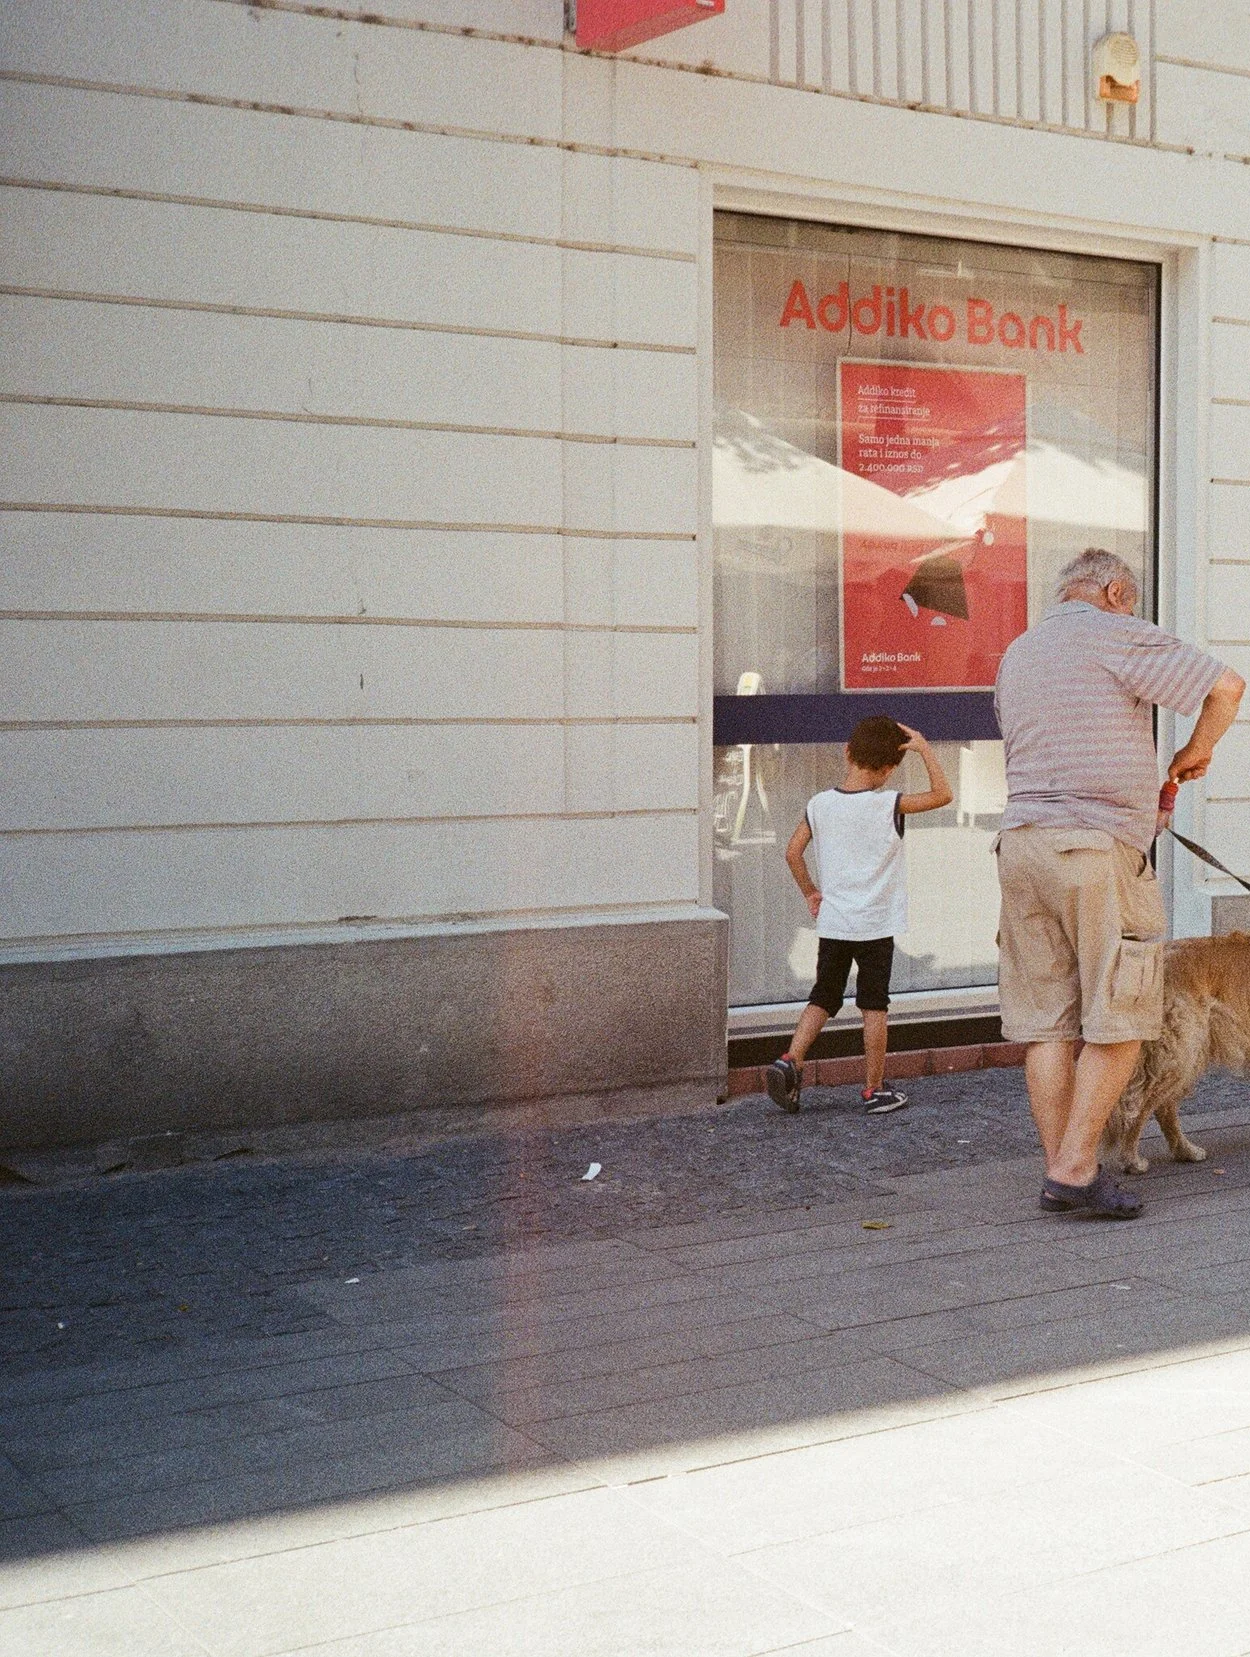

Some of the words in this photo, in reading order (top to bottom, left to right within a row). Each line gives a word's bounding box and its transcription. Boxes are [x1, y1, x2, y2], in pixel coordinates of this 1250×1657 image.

[780, 280, 956, 342] Addiko
[966, 297, 1084, 354] Bank
[858, 385, 889, 396] Addiko
[890, 386, 916, 398] kredit
[859, 434, 884, 444] Samo
[886, 434, 911, 447] jedna
[913, 436, 940, 448] manja
[859, 449, 878, 458] rata
[885, 449, 908, 459] iznos
[910, 449, 922, 459] do
[861, 652, 896, 662] Addiko
[897, 652, 921, 662] Bank
